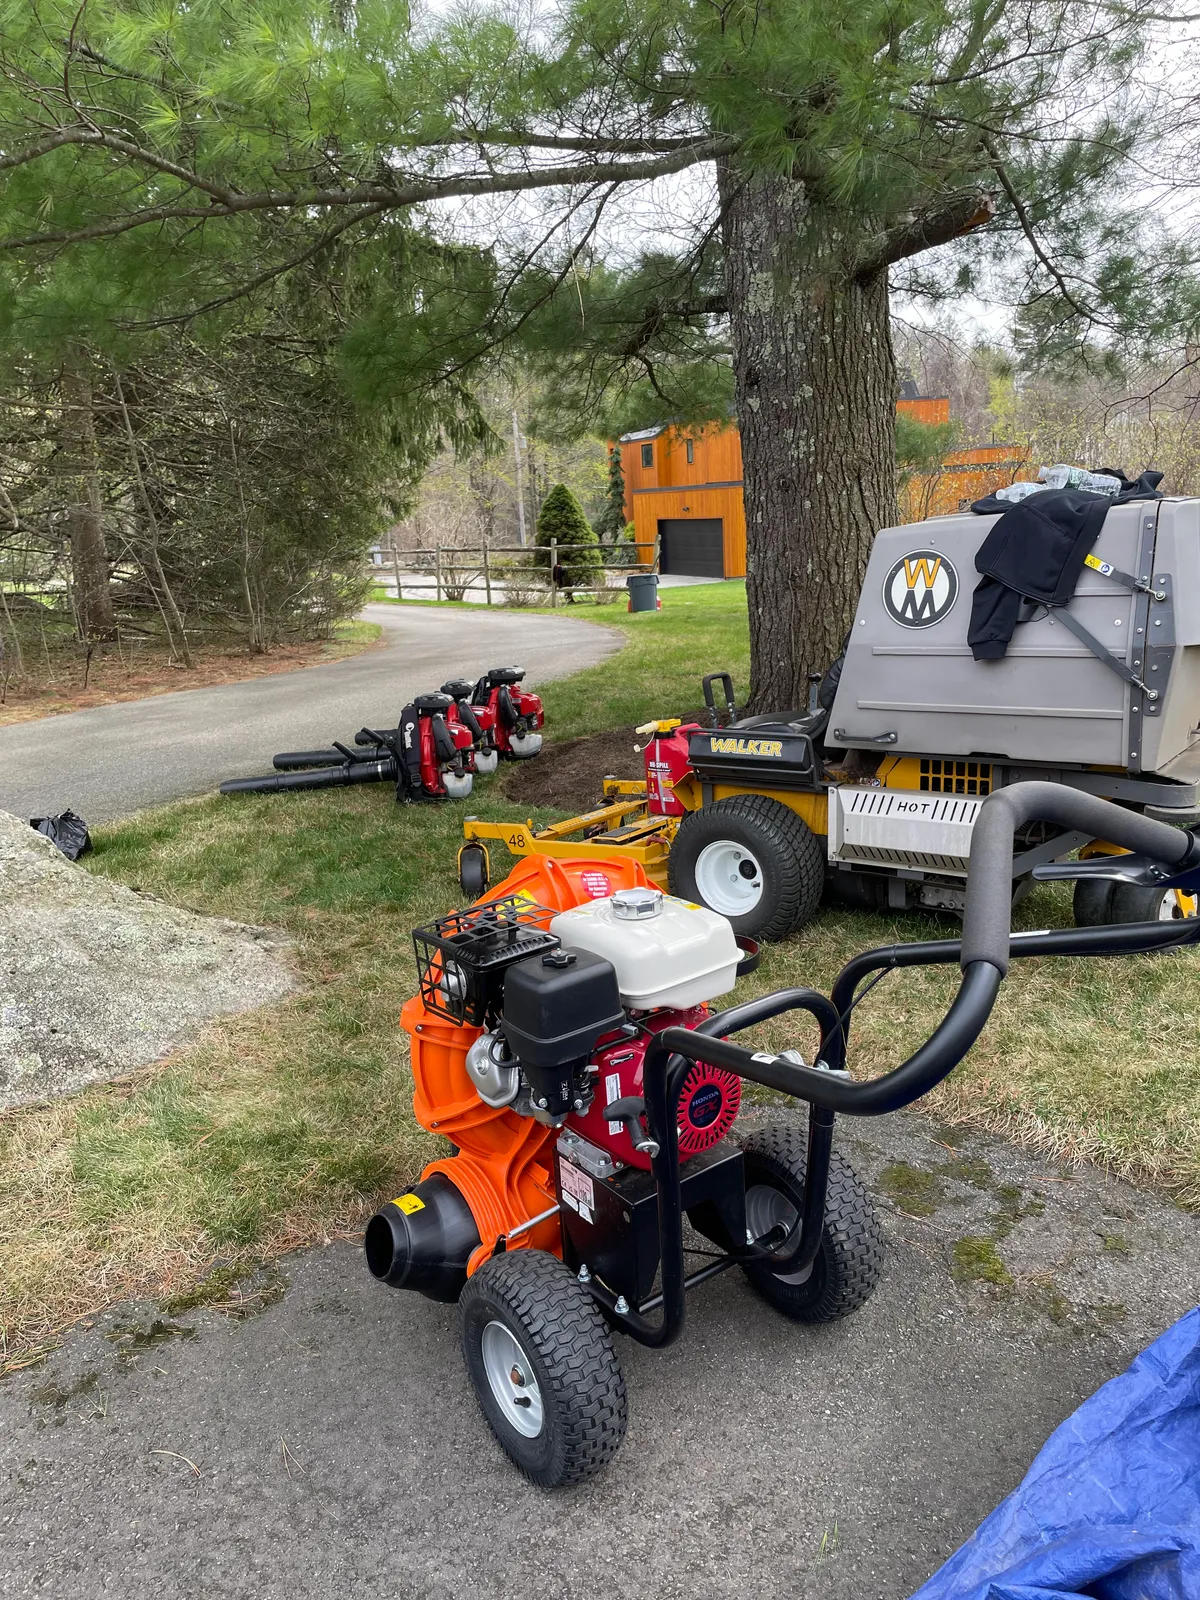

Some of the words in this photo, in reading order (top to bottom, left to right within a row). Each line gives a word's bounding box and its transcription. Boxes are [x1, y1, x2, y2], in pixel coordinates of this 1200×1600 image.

[710, 737, 783, 757] WALKER
[896, 801, 930, 813] HOT
[508, 834, 526, 848] 48
[692, 1091, 719, 1107] HONDA
[693, 1098, 718, 1118] GX
